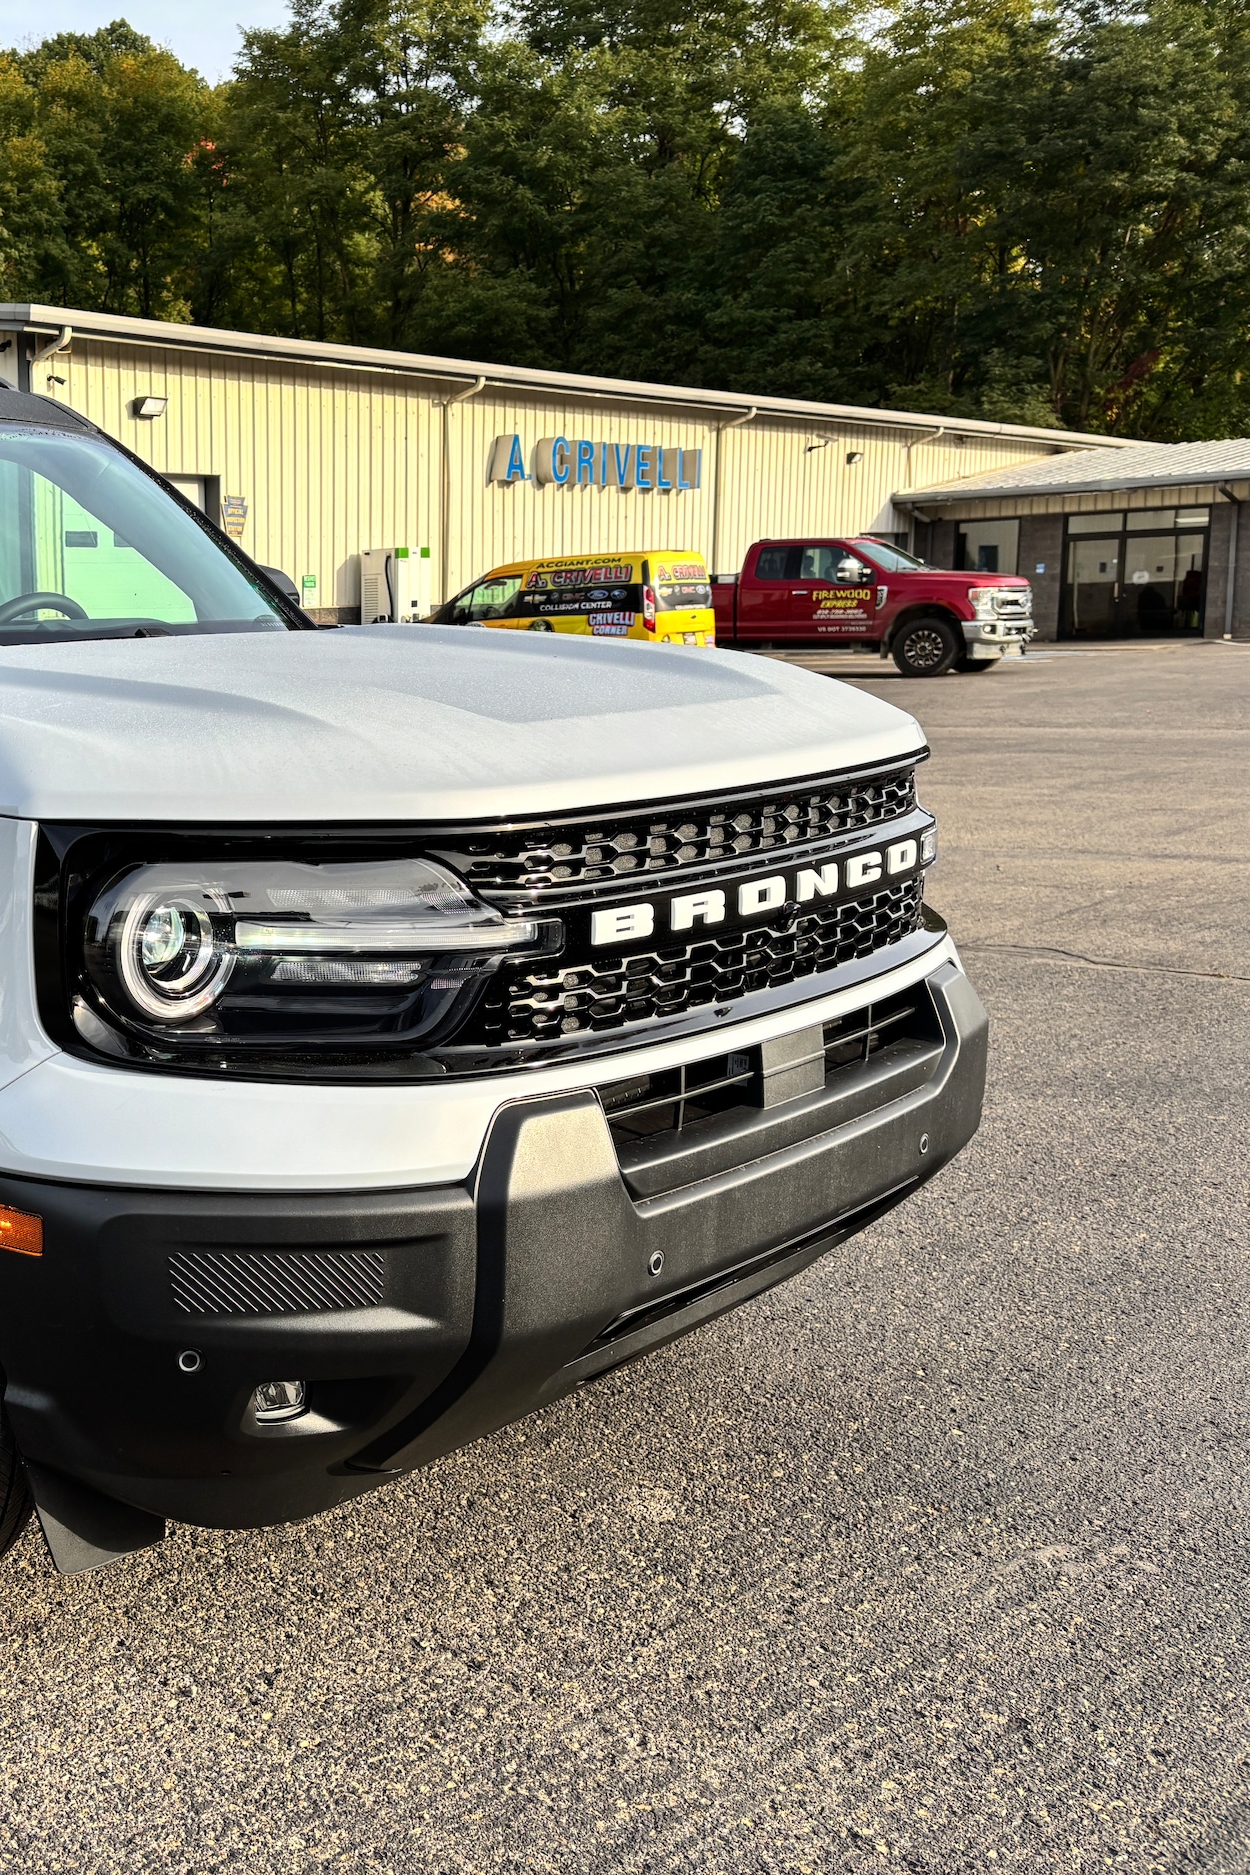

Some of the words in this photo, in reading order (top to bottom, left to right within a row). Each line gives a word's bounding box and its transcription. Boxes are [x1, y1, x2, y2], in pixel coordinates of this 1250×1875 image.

[551, 436, 701, 489] CRIVELLI
[537, 558, 622, 568] ACGIANT.COM
[551, 564, 632, 587] CRIVELLI
[672, 564, 707, 581] CRIVELLI
[562, 592, 586, 601] GMC
[813, 589, 871, 601] FIREWOOD
[539, 602, 580, 612] COLLISION
[580, 600, 613, 610] CENTER
[820, 599, 859, 609] EXPRESS
[589, 612, 636, 627] CRIVELLI
[593, 626, 628, 635] CORNER
[590, 838, 918, 946] BRONCO
